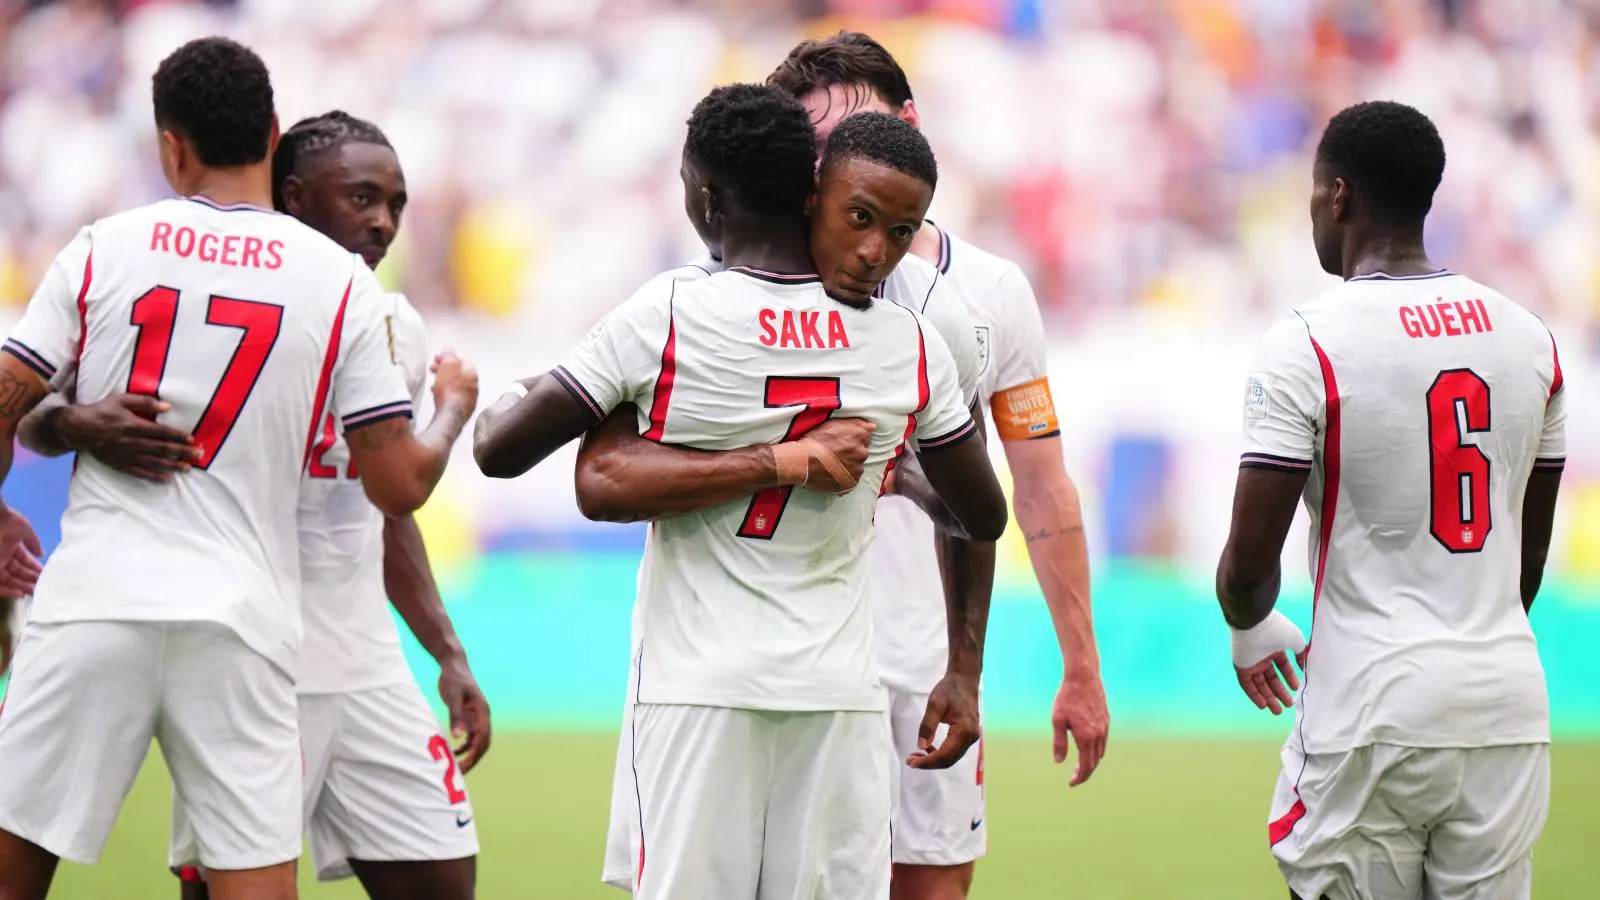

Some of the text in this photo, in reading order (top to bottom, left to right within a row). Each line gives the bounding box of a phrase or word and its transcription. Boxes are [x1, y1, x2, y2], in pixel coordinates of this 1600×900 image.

[150, 222, 285, 270] ROGERS
[758, 308, 850, 349] SAKA
[1399, 297, 1492, 338] GUÉHI
[127, 284, 284, 471] 17
[1008, 392, 1049, 414] UNITES
[736, 375, 841, 540] 7
[1426, 368, 1492, 554] 6
[428, 734, 466, 805] 2
